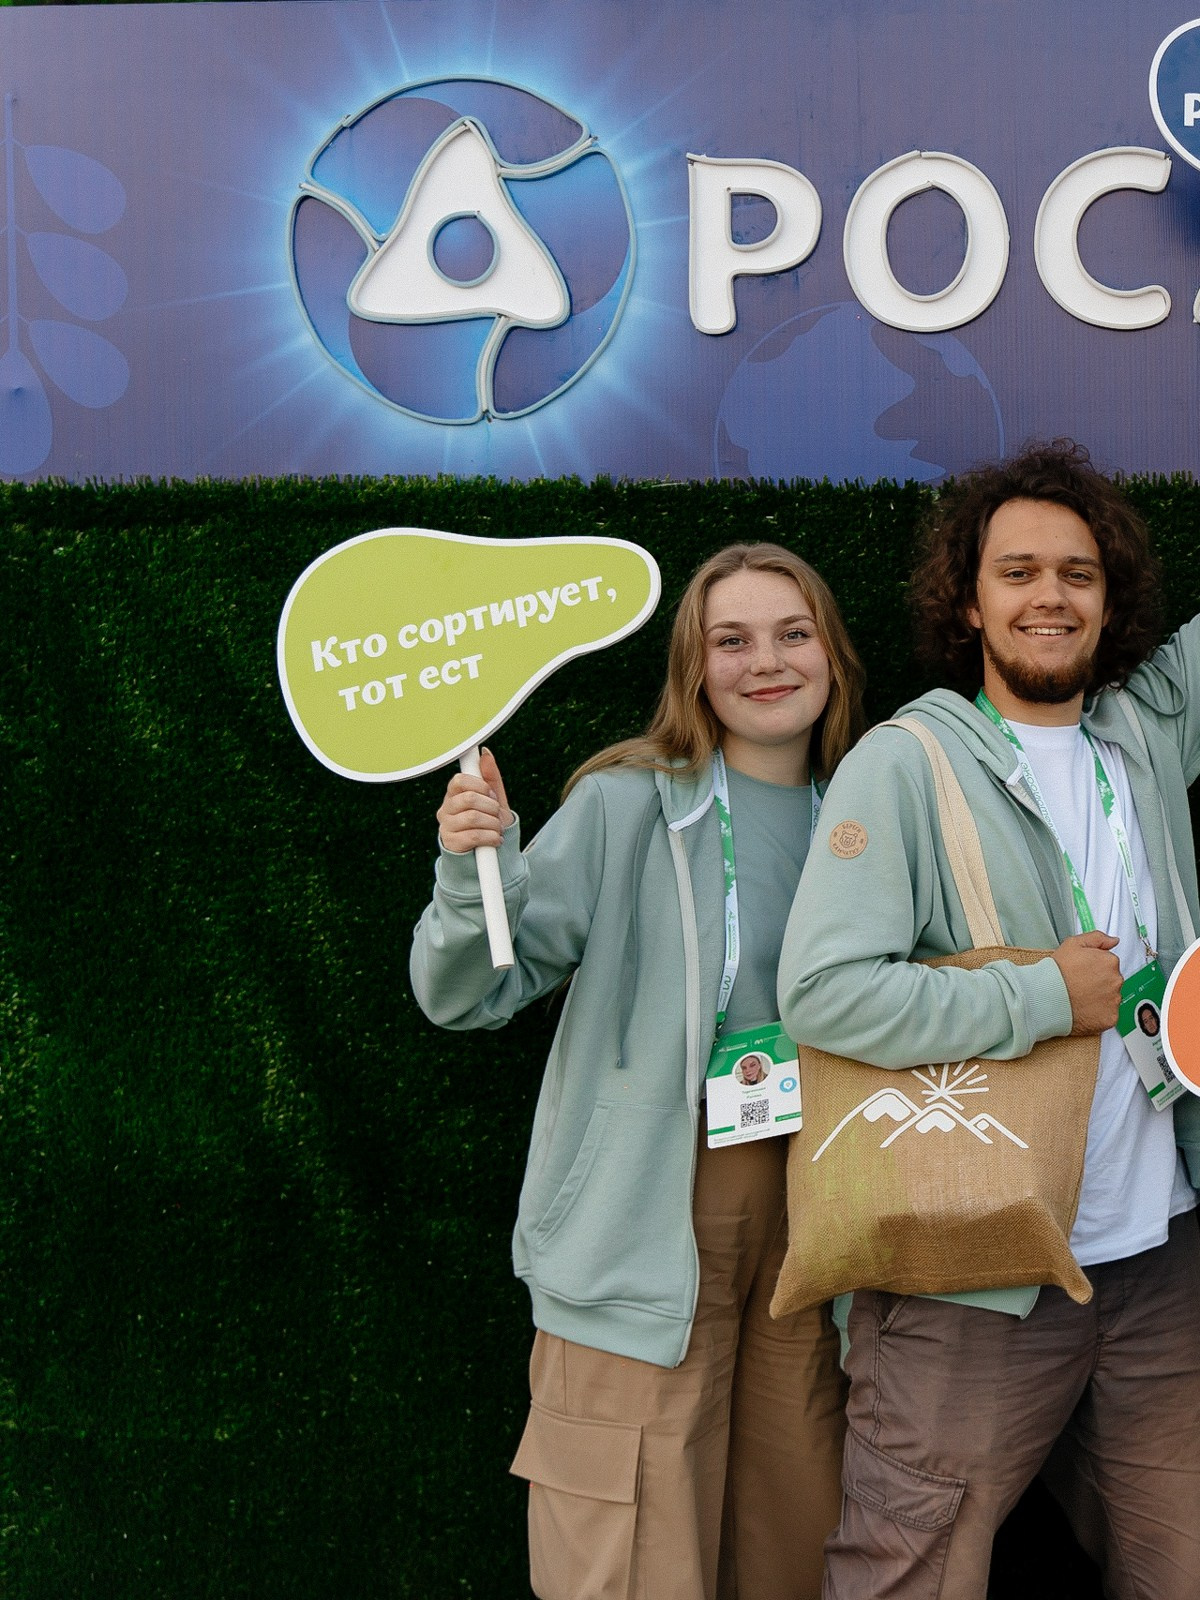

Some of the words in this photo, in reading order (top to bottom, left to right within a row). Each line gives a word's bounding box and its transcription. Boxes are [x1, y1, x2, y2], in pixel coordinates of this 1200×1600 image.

[310, 633, 388, 673] Кто
[397, 575, 617, 647] сортирует,
[338, 673, 407, 712] тот
[418, 653, 484, 690] ест
